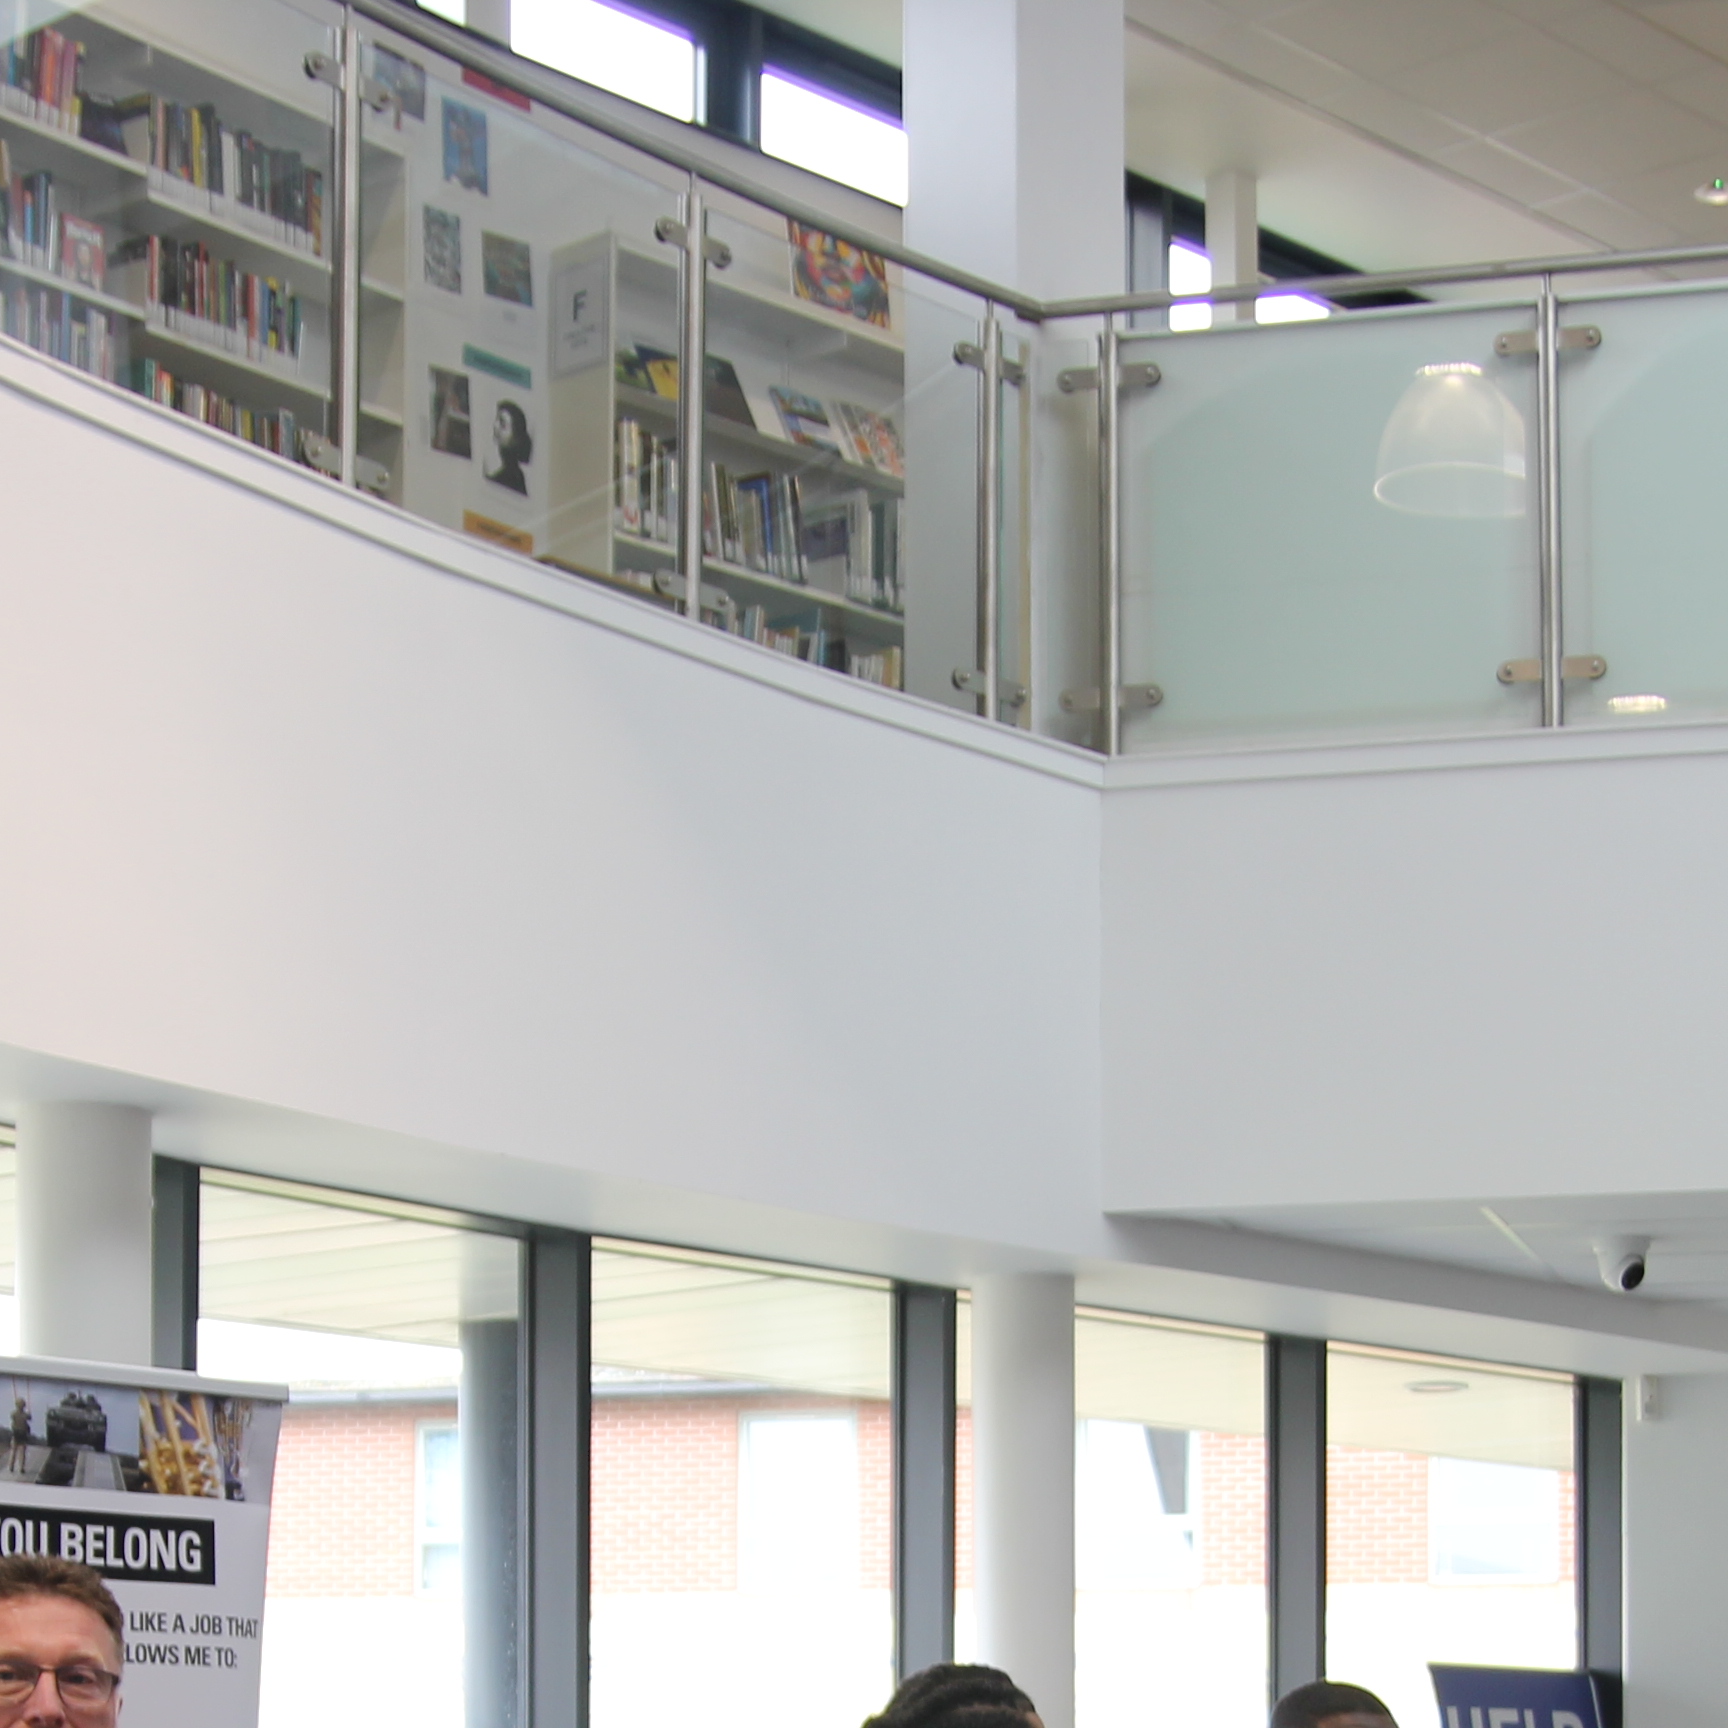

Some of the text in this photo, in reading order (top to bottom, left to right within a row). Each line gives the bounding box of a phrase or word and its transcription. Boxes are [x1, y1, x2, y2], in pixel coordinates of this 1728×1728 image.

[574, 289, 587, 321] F
[59, 1521, 202, 1572] BELONG
[129, 1611, 259, 1639] LIKE A JOB THAT
[125, 1644, 238, 1669] LOWS ME TO:
